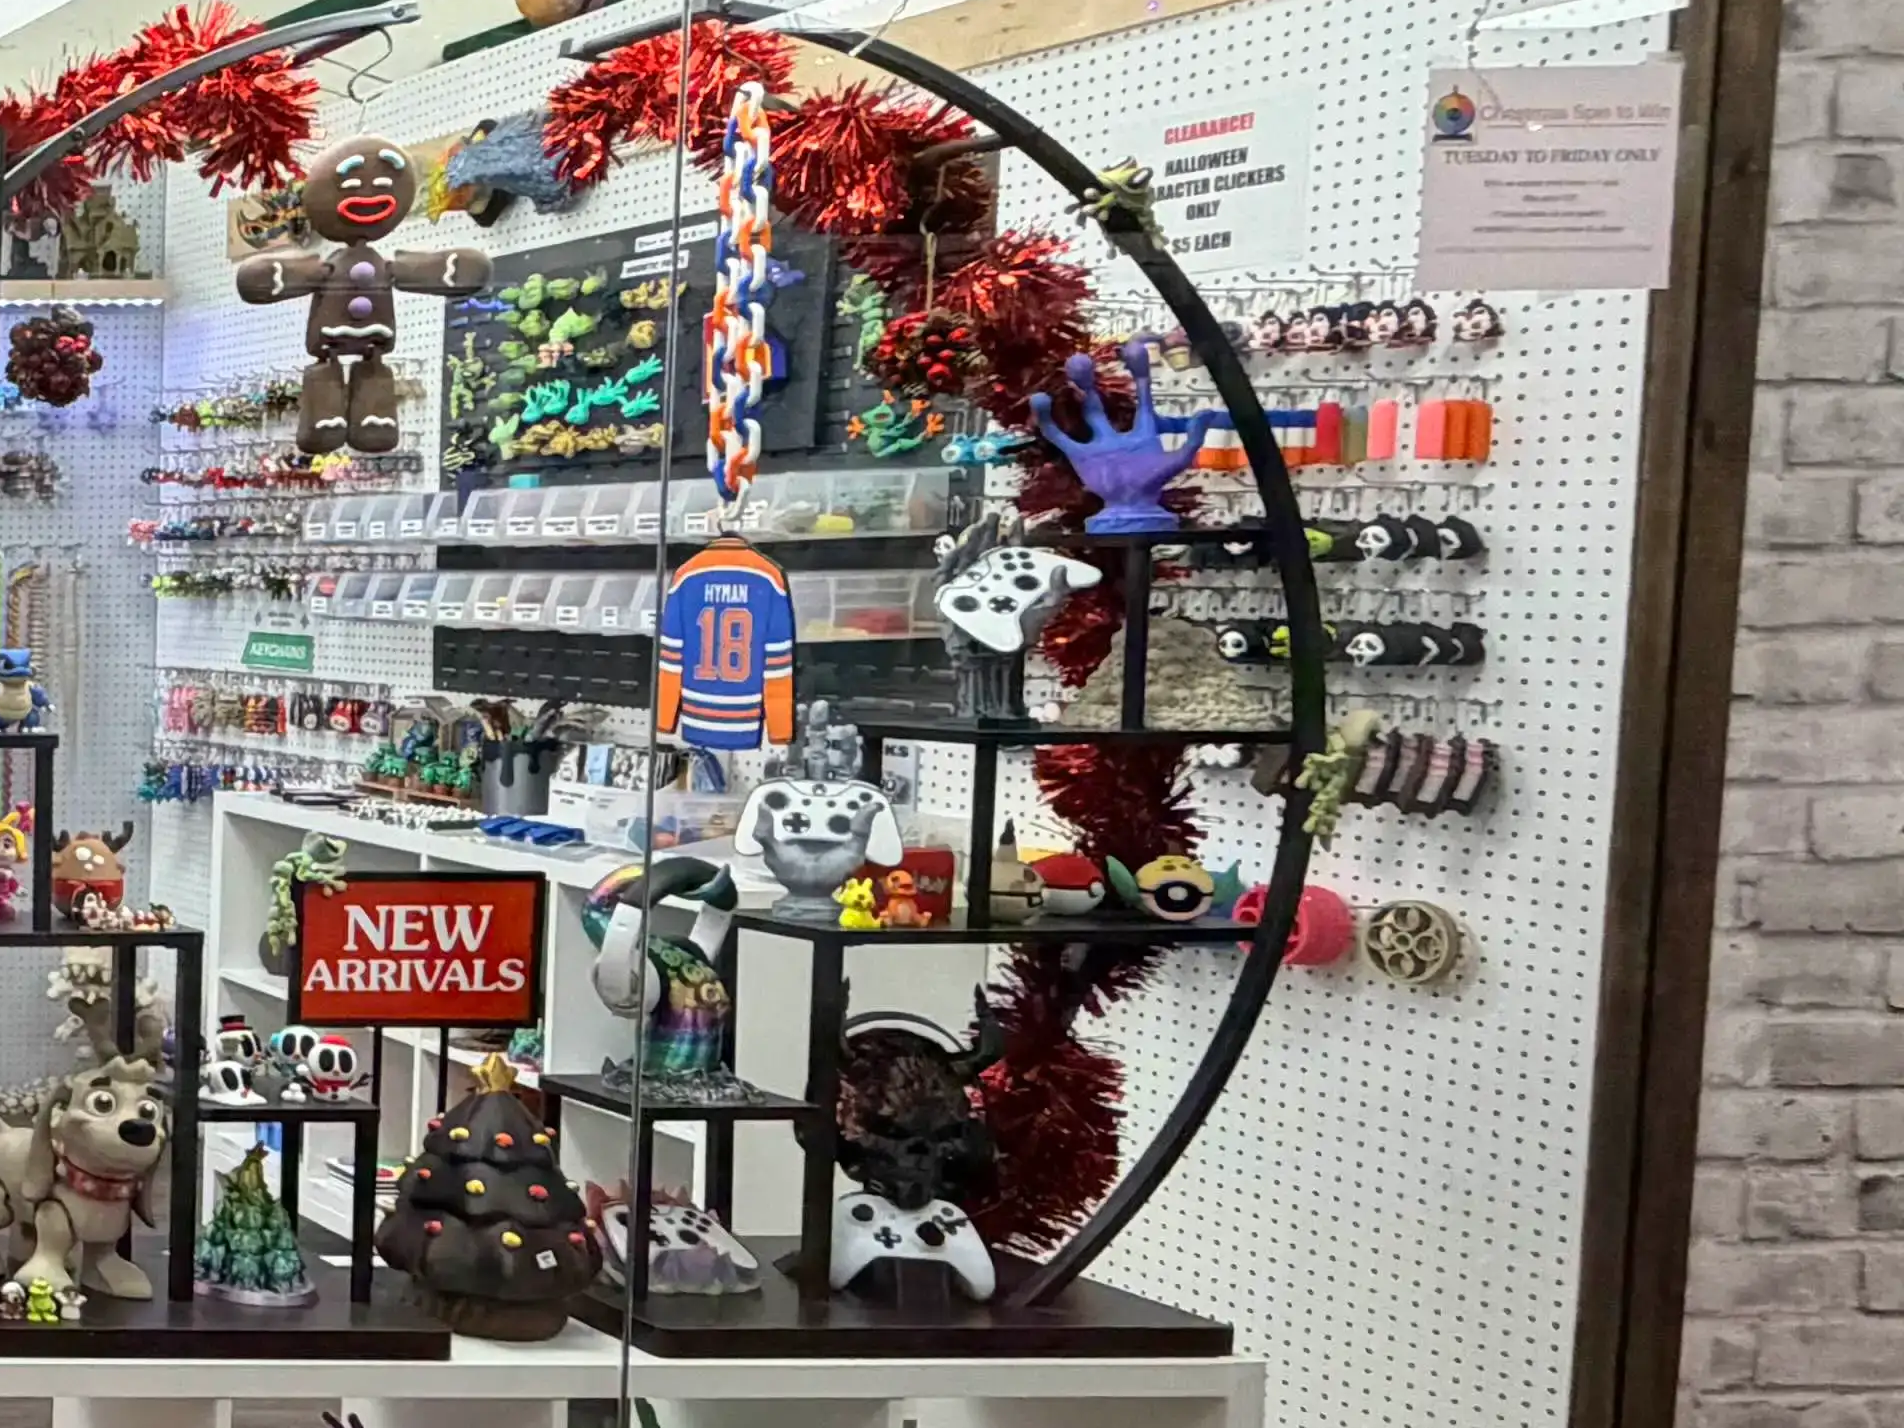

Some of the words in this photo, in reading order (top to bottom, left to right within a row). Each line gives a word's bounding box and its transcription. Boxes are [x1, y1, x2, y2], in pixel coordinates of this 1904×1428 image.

[1164, 112, 1255, 145] CLEARANCE!
[1165, 146, 1249, 177] HALLOWEEN
[1443, 149, 1521, 165] TUESDAY
[1525, 149, 1547, 164] TO
[1550, 148, 1611, 164] FRIDAY
[1614, 147, 1661, 162] ONLY
[1214, 164, 1286, 192] CLICKERS
[1186, 199, 1222, 221] ONLY
[1194, 231, 1232, 252] EACH
[704, 583, 749, 604] HYMAN
[693, 606, 754, 683] 18
[342, 904, 494, 953] NEW
[303, 958, 526, 992] ARRIVALS
